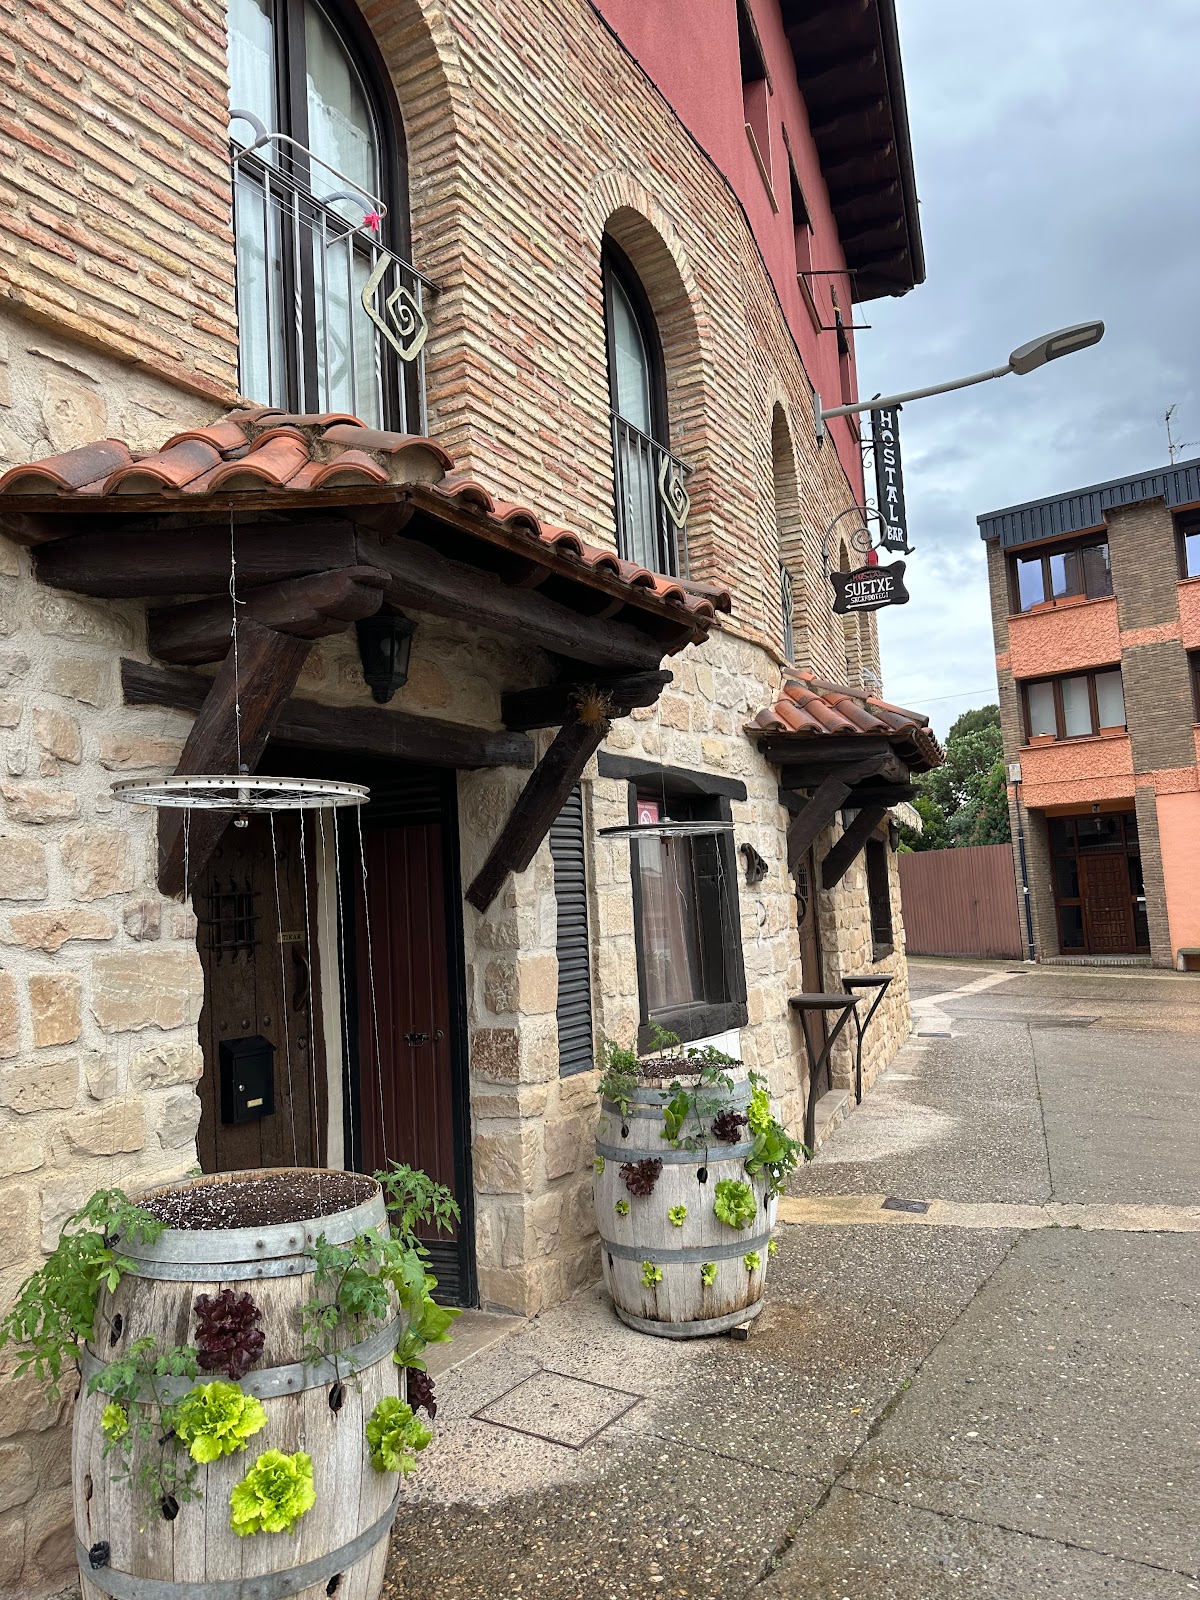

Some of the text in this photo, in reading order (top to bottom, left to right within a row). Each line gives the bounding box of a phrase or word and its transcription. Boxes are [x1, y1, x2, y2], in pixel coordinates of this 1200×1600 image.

[880, 410, 899, 522] HOSTAL
[887, 525, 904, 542] BAR
[844, 576, 895, 599] SUETXE
